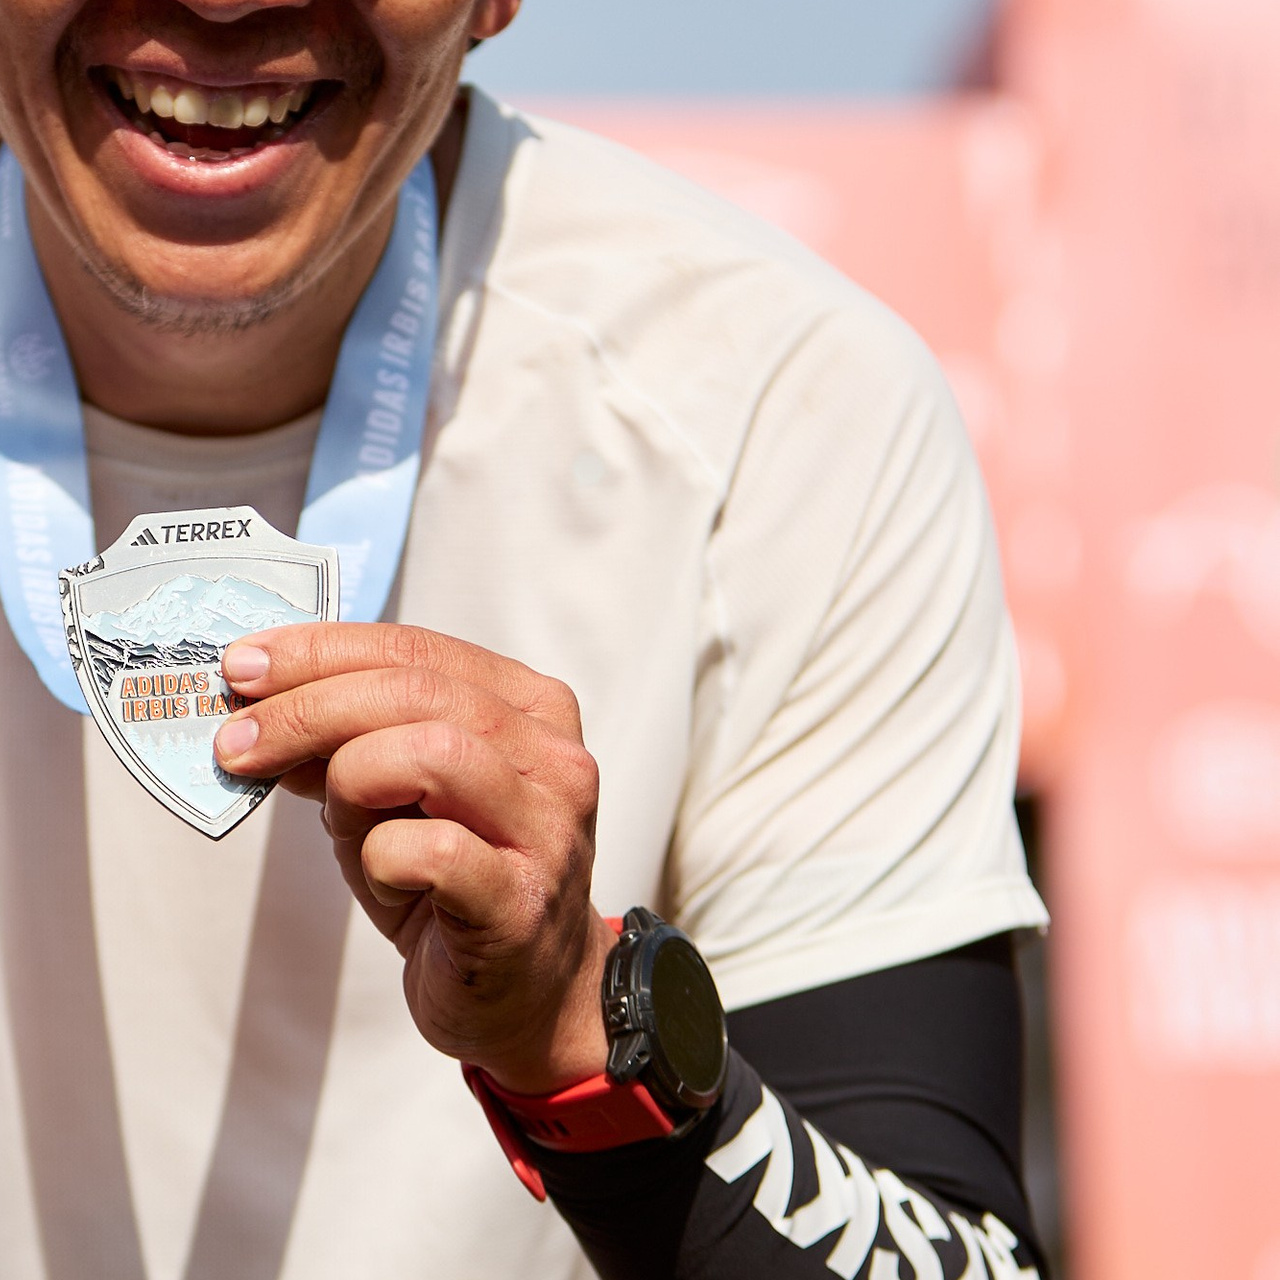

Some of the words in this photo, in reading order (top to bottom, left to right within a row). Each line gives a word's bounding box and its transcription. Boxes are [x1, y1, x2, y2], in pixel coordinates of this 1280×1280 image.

[161, 519, 252, 544] TERREX
[121, 672, 209, 699] ADIDAS
[122, 696, 190, 723] IRBIS
